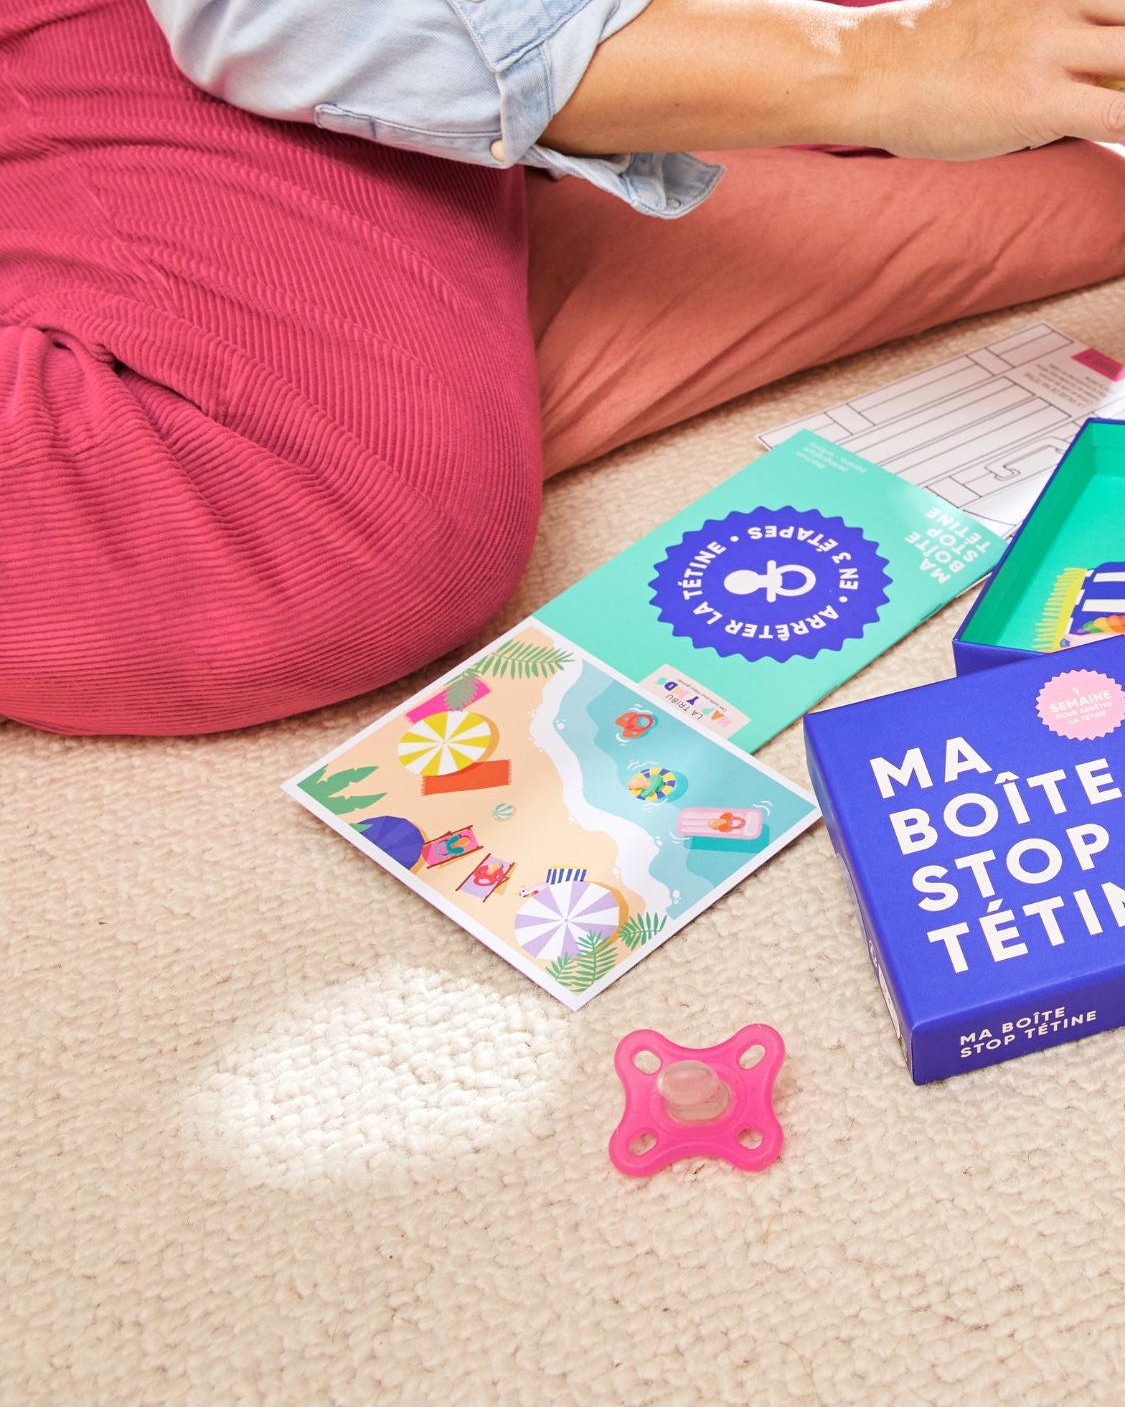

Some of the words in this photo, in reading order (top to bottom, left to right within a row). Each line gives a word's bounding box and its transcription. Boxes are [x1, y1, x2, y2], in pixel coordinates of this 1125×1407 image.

[747, 525, 839, 553] ÉTAPES
[925, 506, 991, 553] TÉTINE
[926, 527, 979, 562] STOP
[831, 551, 852, 564] 3
[904, 531, 965, 573] BOÎTE
[677, 541, 727, 600] TÉTINE
[839, 567, 859, 590] EN
[919, 558, 951, 584] MA
[693, 601, 724, 625] LA
[724, 604, 840, 641] ARRÊTER
[665, 694, 690, 712] TRIBU
[1049, 689, 1112, 713] SEMAINE
[1071, 687, 1080, 696] 1
[686, 696, 732, 727] HAPY
[691, 709, 704, 721] LA
[1055, 710, 1078, 721] POUR
[869, 736, 993, 799] MA
[889, 757, 1123, 856] BOÎTE
[911, 823, 1110, 912] STOP
[960, 1028, 993, 1045] MA
[1002, 1006, 1066, 1034] BOÎTE
[960, 1034, 1016, 1058] STOP
[1024, 1010, 1097, 1039] TÉTINE
